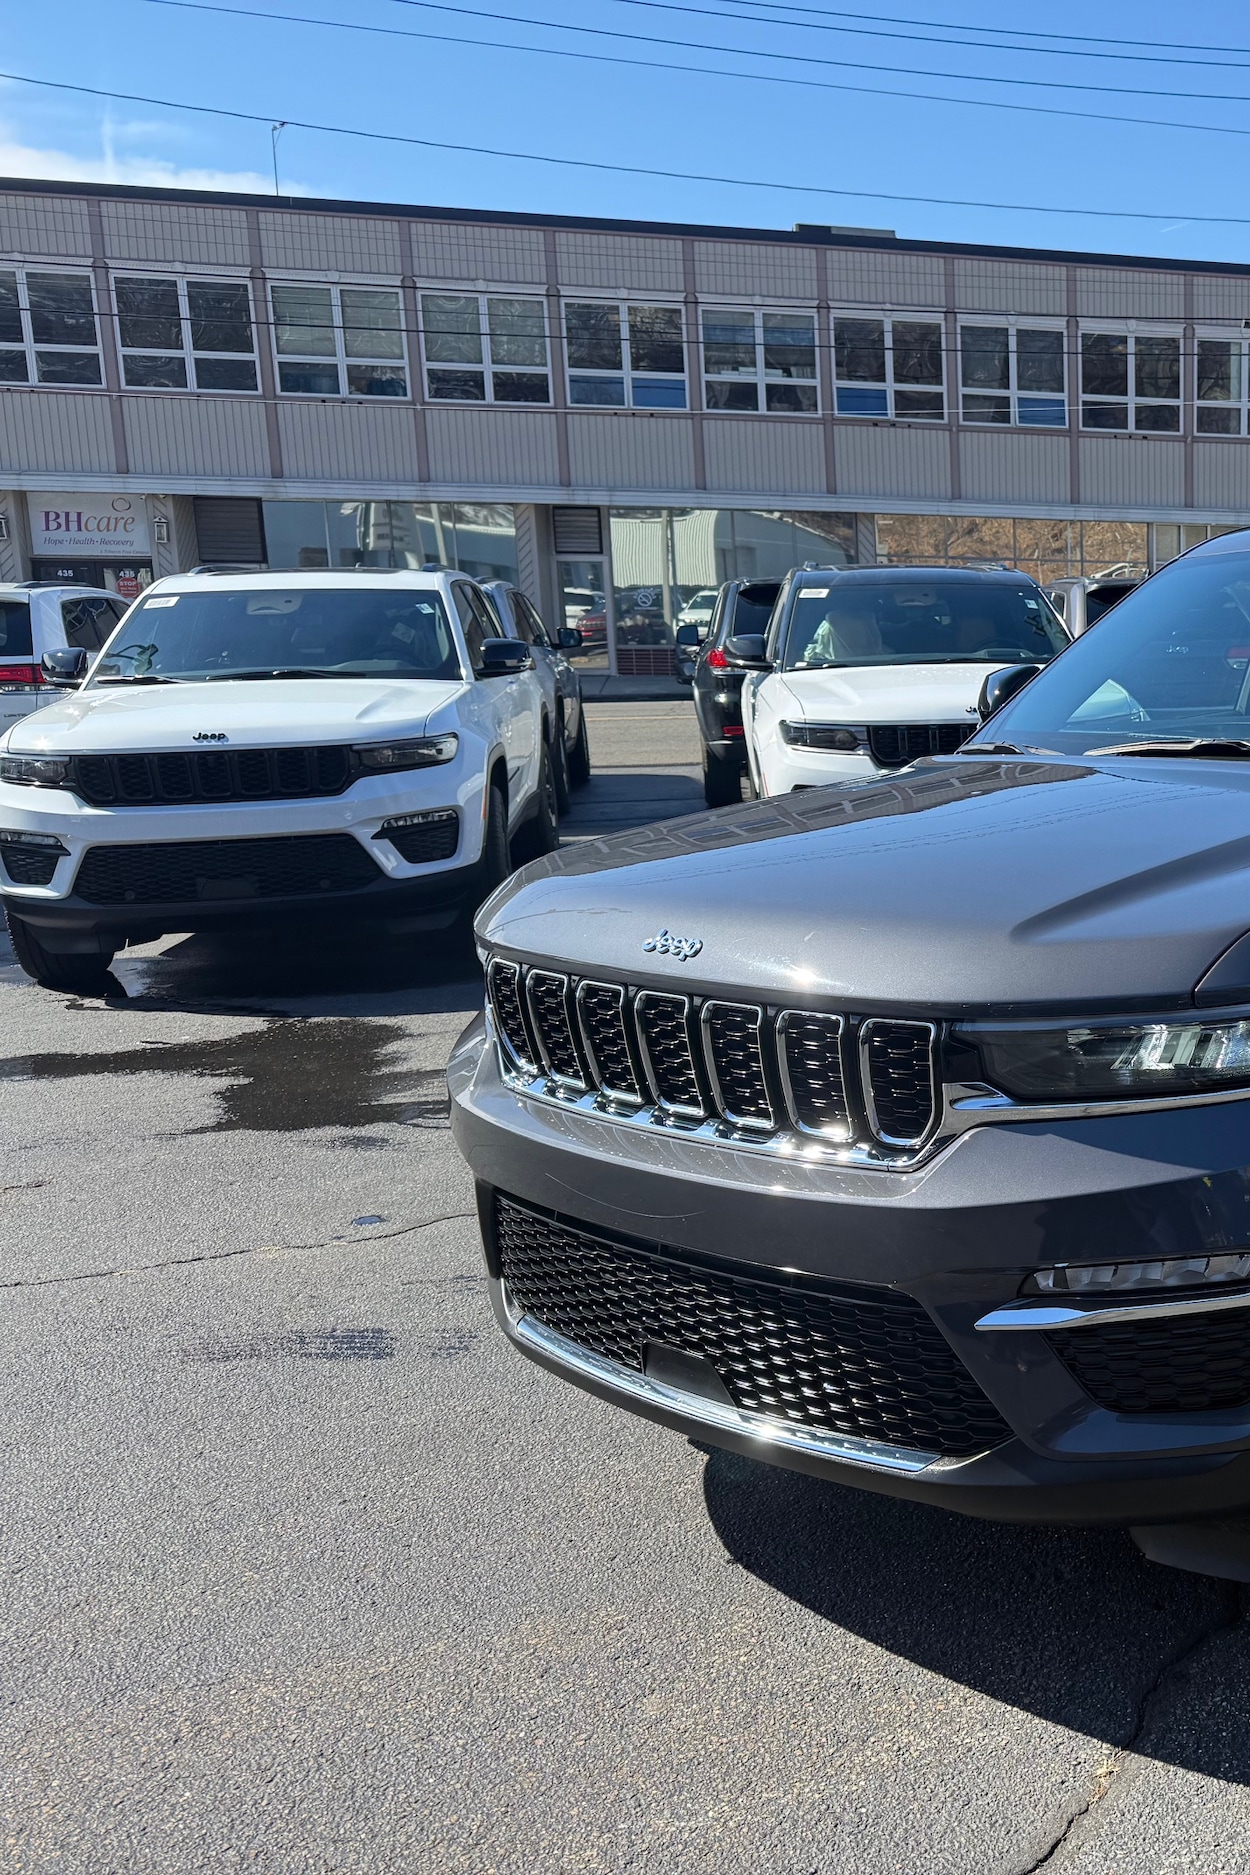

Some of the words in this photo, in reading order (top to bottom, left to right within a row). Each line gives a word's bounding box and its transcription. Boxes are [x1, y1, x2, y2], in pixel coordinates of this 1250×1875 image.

[40, 510, 136, 533] BHcare
[57, 569, 74, 577] 435
[119, 570, 135, 578] 435
[192, 732, 226, 741] Jeep
[641, 928, 704, 962] Jeep
